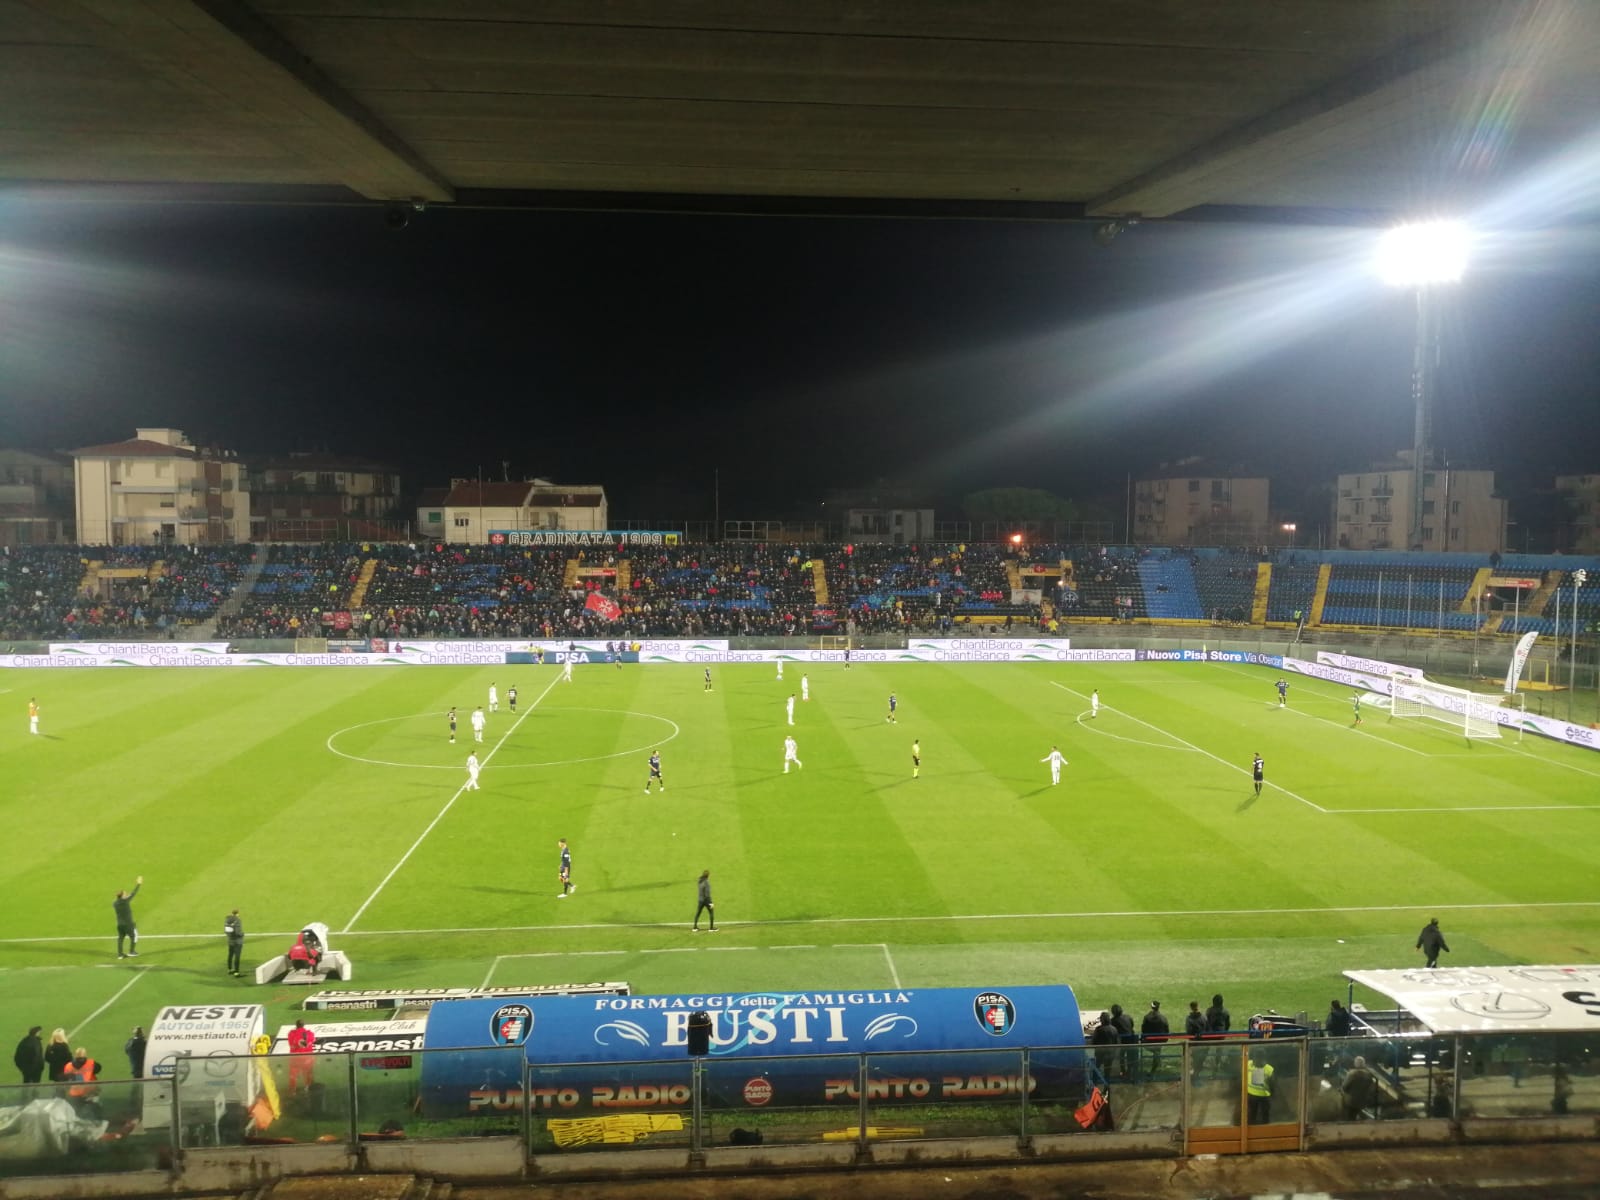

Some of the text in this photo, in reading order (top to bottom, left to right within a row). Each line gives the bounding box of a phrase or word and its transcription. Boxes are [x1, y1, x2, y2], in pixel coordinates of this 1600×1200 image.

[509, 532, 663, 545] GRADINATA 1909
[98, 643, 178, 655] ChiantiBanca
[435, 641, 512, 652] ChiantiBanca
[951, 639, 1023, 649] ChiantiBanca
[13, 655, 97, 667] ChiantiBanca
[150, 654, 233, 666] ChiantiBanca
[286, 654, 369, 665] ChiantiBanca
[420, 652, 501, 664] ChiantiBanca
[555, 652, 590, 664] PISA
[685, 650, 763, 662] ChiantiBanca
[810, 650, 887, 661] ChianBanca
[934, 650, 1010, 661] ChiantiBanca
[1057, 650, 1132, 661] ChiantiBanca
[1147, 650, 1181, 660] Nuovo
[1183, 650, 1207, 660] Pisa
[1210, 650, 1242, 661] Store
[1243, 651, 1257, 663] Via
[1341, 656, 1388, 675] ChiantiBanca
[1307, 664, 1352, 684] ChiantiBanca
[327, 1000, 378, 1010] esanastri
[594, 992, 910, 1010] FORMAGGI della FAMIGLIA
[978, 995, 1009, 1006] PISA
[162, 1006, 257, 1021] NESTI
[497, 1007, 530, 1017] PISA
[156, 1021, 250, 1031] AUTO dal 1965
[662, 1007, 849, 1047] BUSTI
[154, 1031, 248, 1041] www.nestiauto.it
[312, 1036, 423, 1052] sanast
[942, 1074, 1037, 1097] RADIO
[592, 1084, 691, 1108] RADIO
